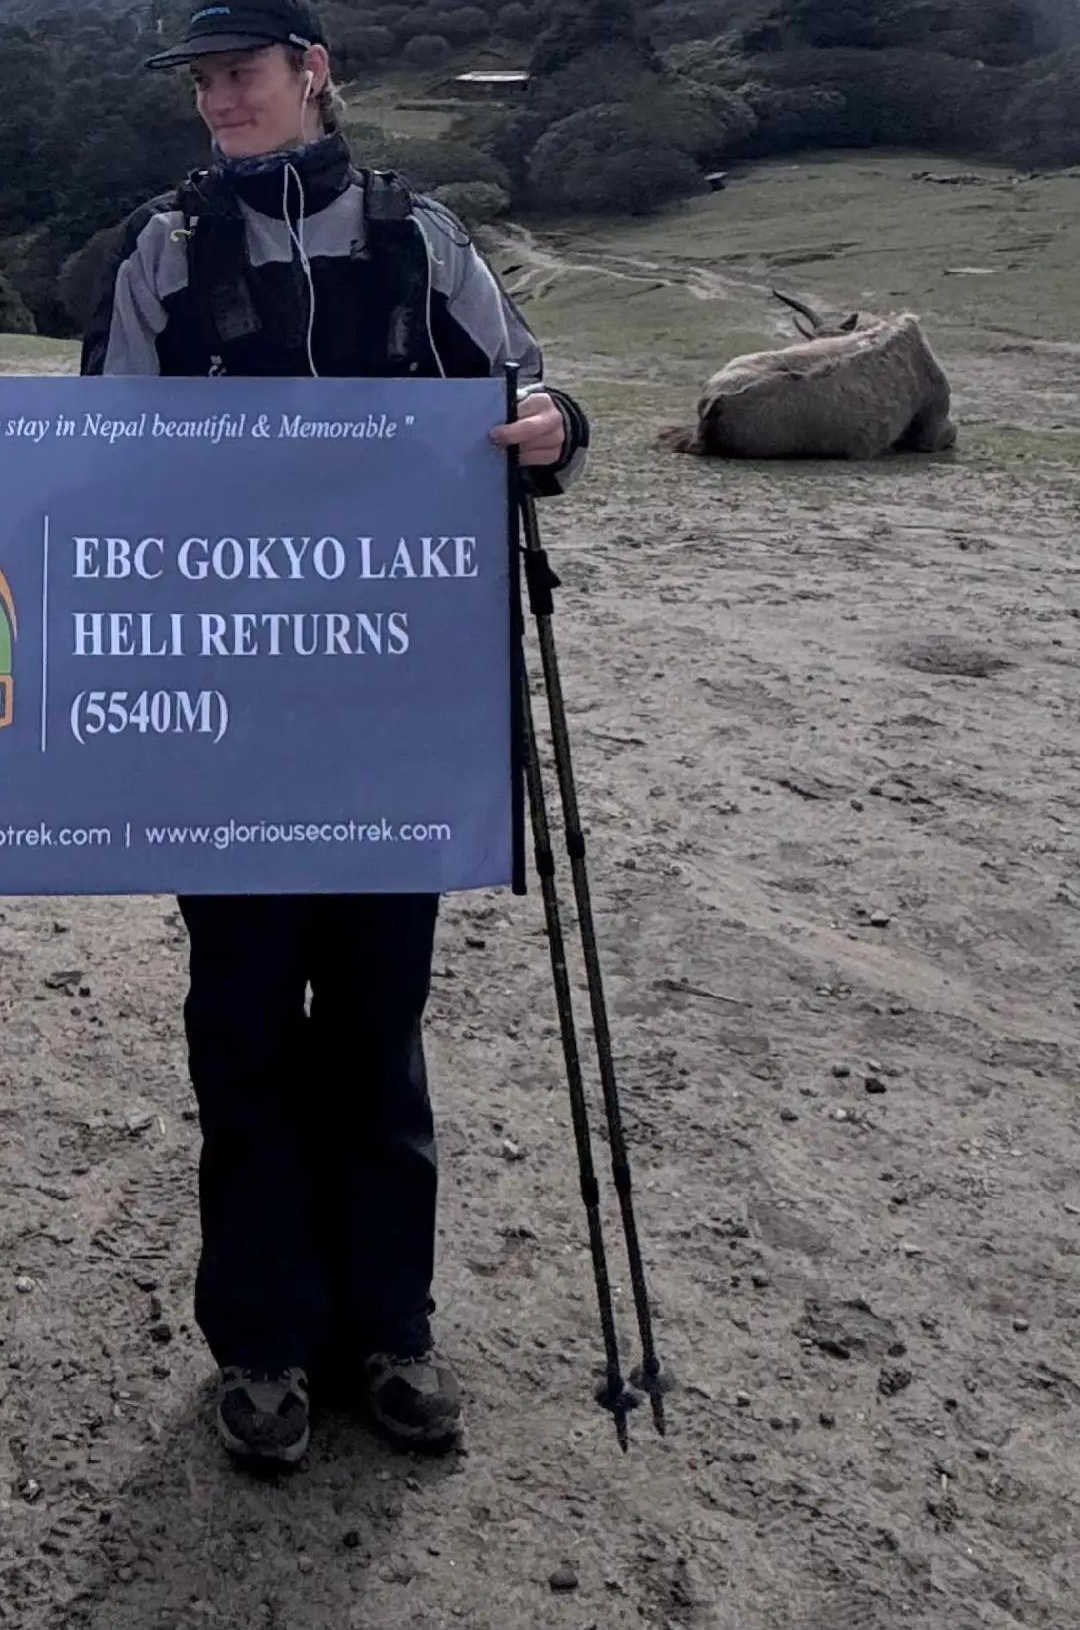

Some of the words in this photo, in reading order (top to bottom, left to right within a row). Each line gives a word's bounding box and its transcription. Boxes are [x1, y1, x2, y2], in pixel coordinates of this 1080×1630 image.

[5, 416, 50, 443] stay
[55, 414, 76, 437] in
[81, 413, 146, 444] Nepal
[151, 413, 246, 444] beautiful
[251, 415, 271, 438] &
[278, 414, 397, 438] Memorable
[72, 537, 164, 580] EBC
[177, 536, 346, 580] GOKYO
[357, 536, 479, 579] LAKE
[71, 612, 184, 656] HELI
[197, 612, 410, 656] RETURNS
[70, 690, 229, 745] (5540M)
[145, 817, 451, 850] www.gloriousecotrek.com
